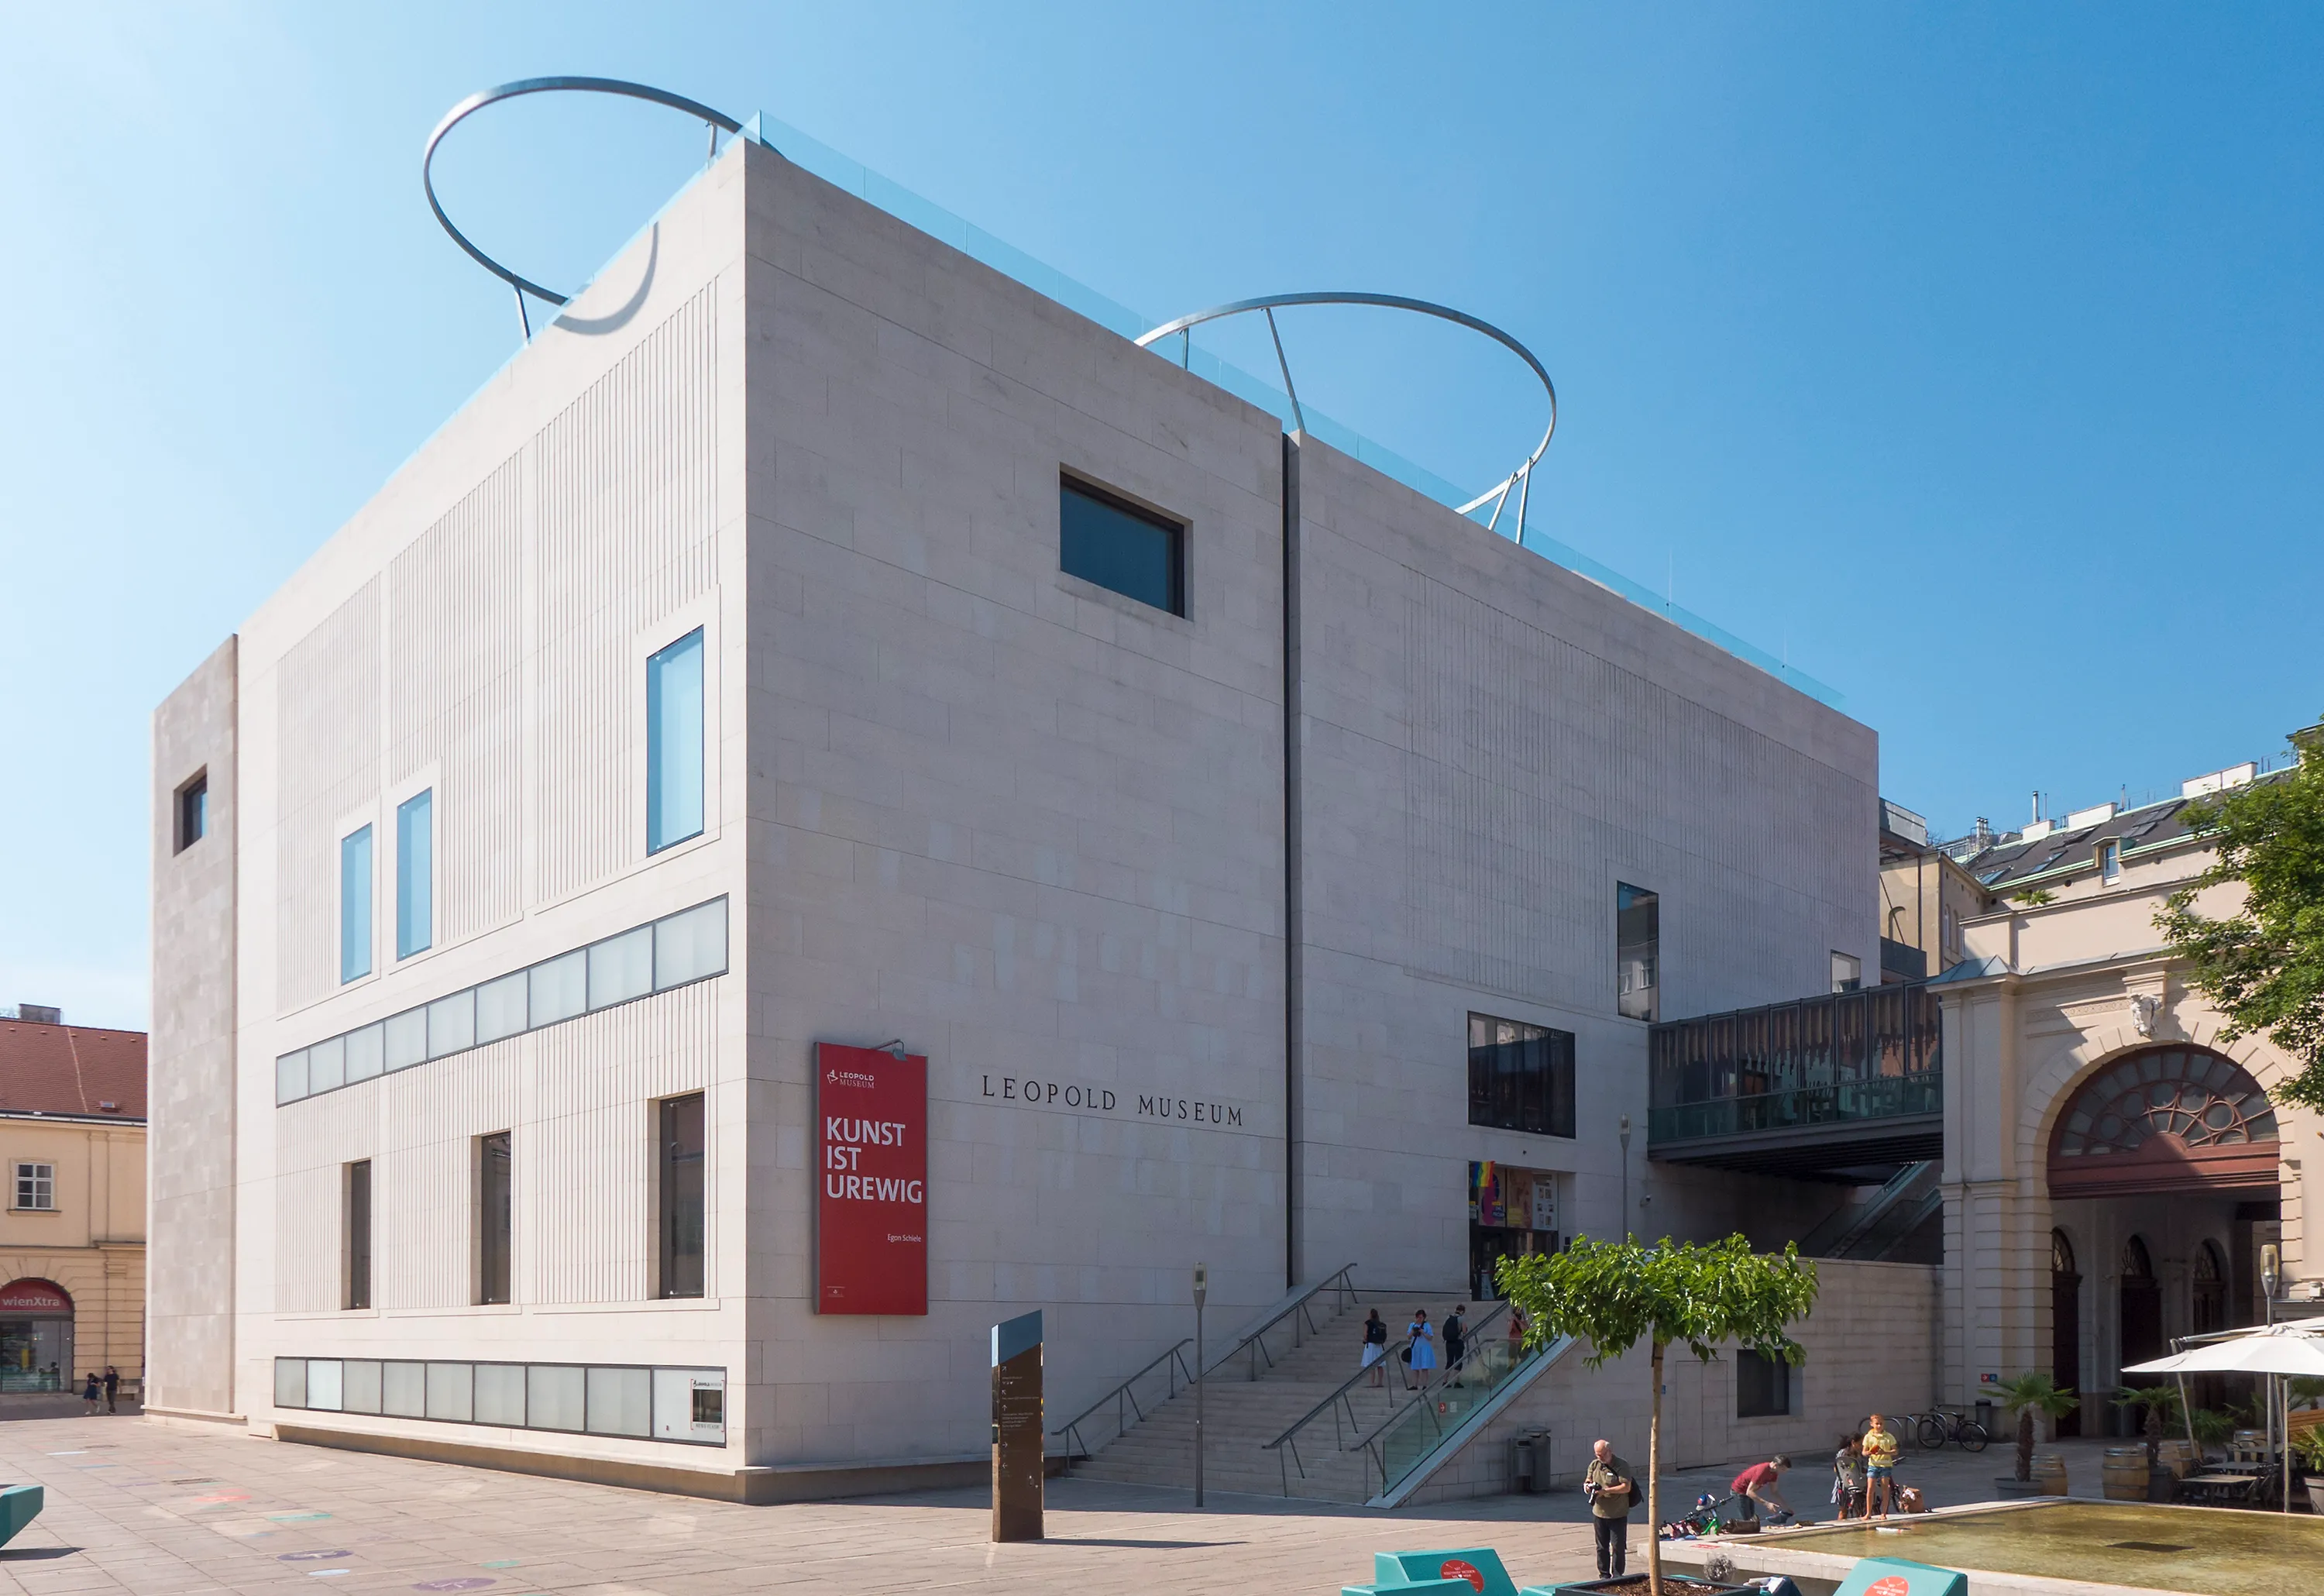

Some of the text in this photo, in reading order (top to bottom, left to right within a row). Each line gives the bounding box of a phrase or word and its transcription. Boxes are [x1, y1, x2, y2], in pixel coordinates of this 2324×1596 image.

[839, 1071, 875, 1082] LEOPOLD
[839, 1078, 875, 1089] MUSEUM
[982, 1075, 1243, 1126] LEOPOLD MUSEUM
[827, 1116, 906, 1147] KUNST
[827, 1145, 861, 1171] IST
[827, 1174, 922, 1203] UREWIG
[887, 1233, 922, 1243] Egon Schiele
[2, 1296, 60, 1306] wienXtra
